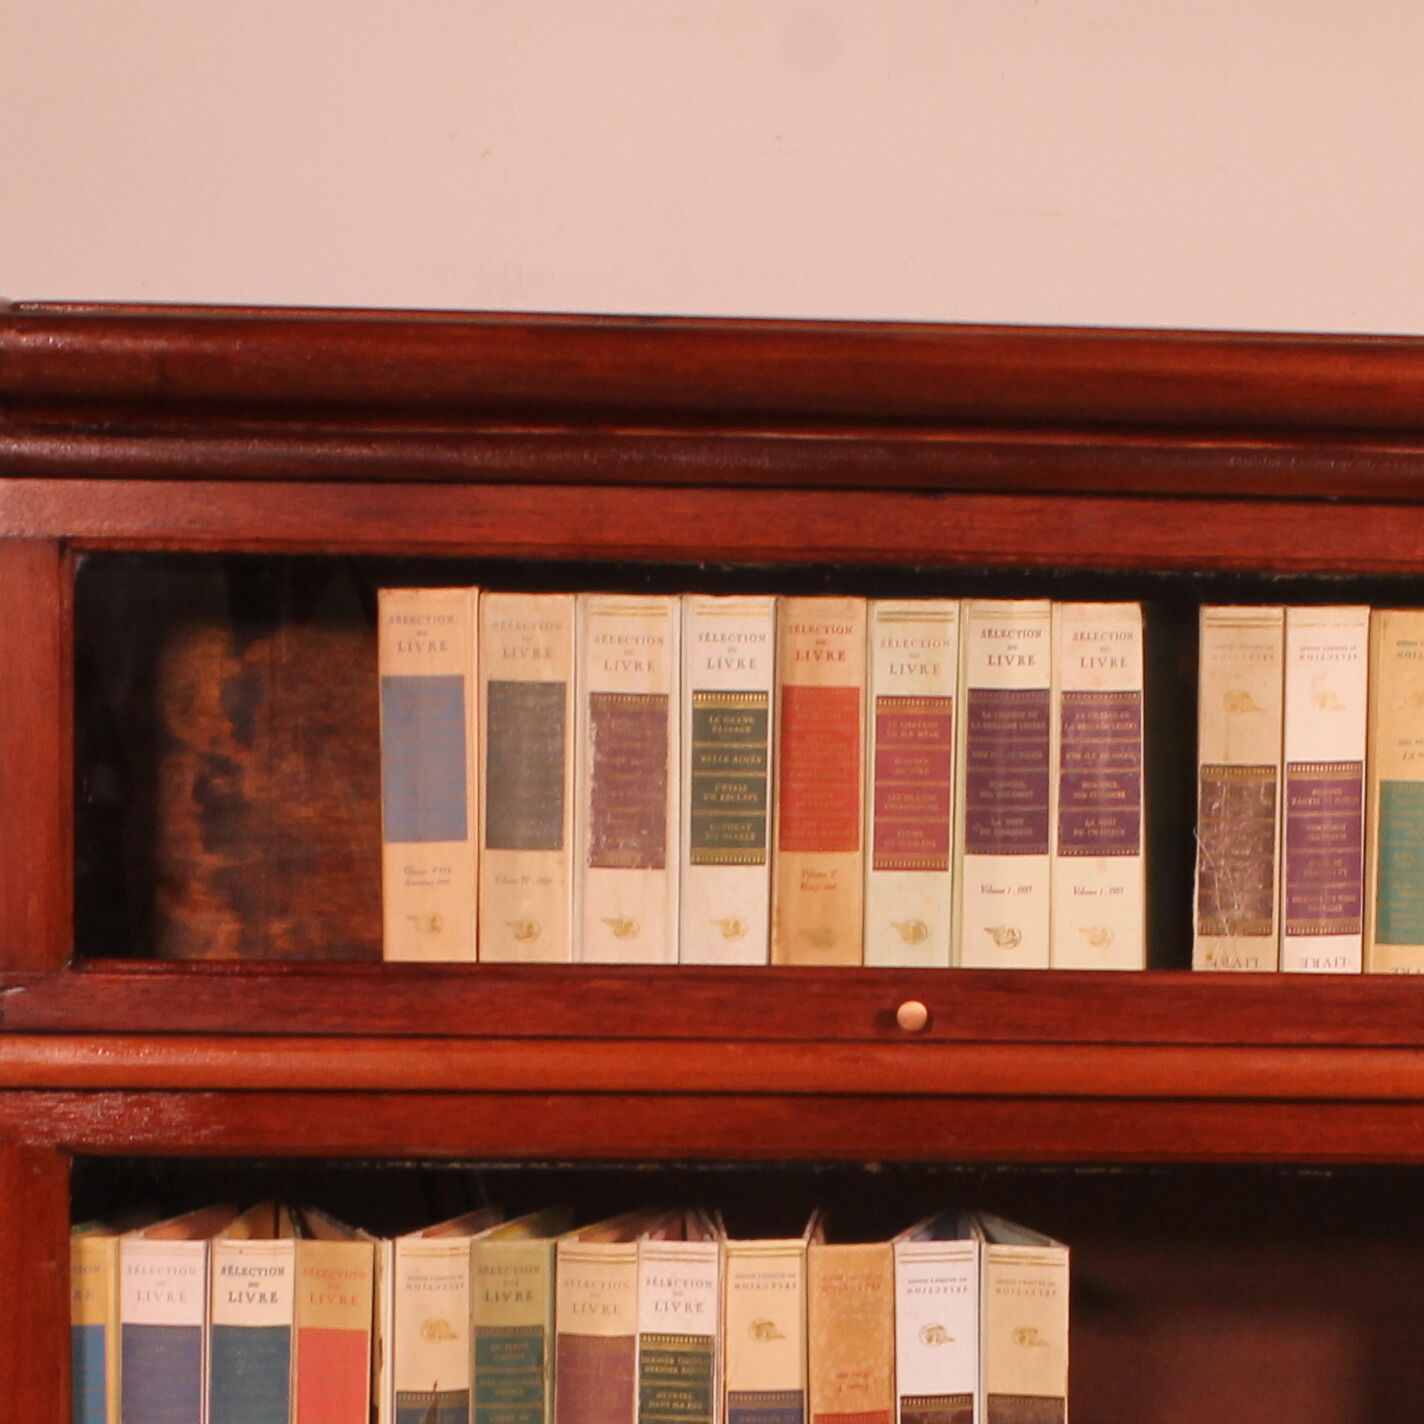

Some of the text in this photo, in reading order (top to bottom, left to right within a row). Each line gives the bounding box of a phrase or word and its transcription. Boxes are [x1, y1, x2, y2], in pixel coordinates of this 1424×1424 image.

[697, 630, 767, 642] SÉLECTION
[980, 627, 1043, 640] SÉLECTION
[396, 640, 448, 654] LIVRE
[502, 646, 554, 659] LIVRE
[794, 649, 847, 662] LIVRE
[986, 654, 1036, 666] LIVRE
[603, 658, 656, 672] LIVRE
[705, 657, 759, 670] LIVRE
[1079, 656, 1129, 669] LIVRE
[888, 663, 942, 676] LIVRE
[980, 884, 1006, 894] Volume
[1072, 885, 1098, 895] Volume
[1300, 956, 1347, 968] LIVRE
[220, 1264, 285, 1276] SÉLECTION
[644, 1276, 713, 1289] SÉLECTION
[136, 1290, 187, 1304] LIVRE
[227, 1290, 279, 1304] LIVRE
[309, 1292, 360, 1306] LIVRE
[484, 1290, 534, 1303] LIVRE
[571, 1302, 622, 1315] LIVRE
[654, 1302, 704, 1314] LIVRE
